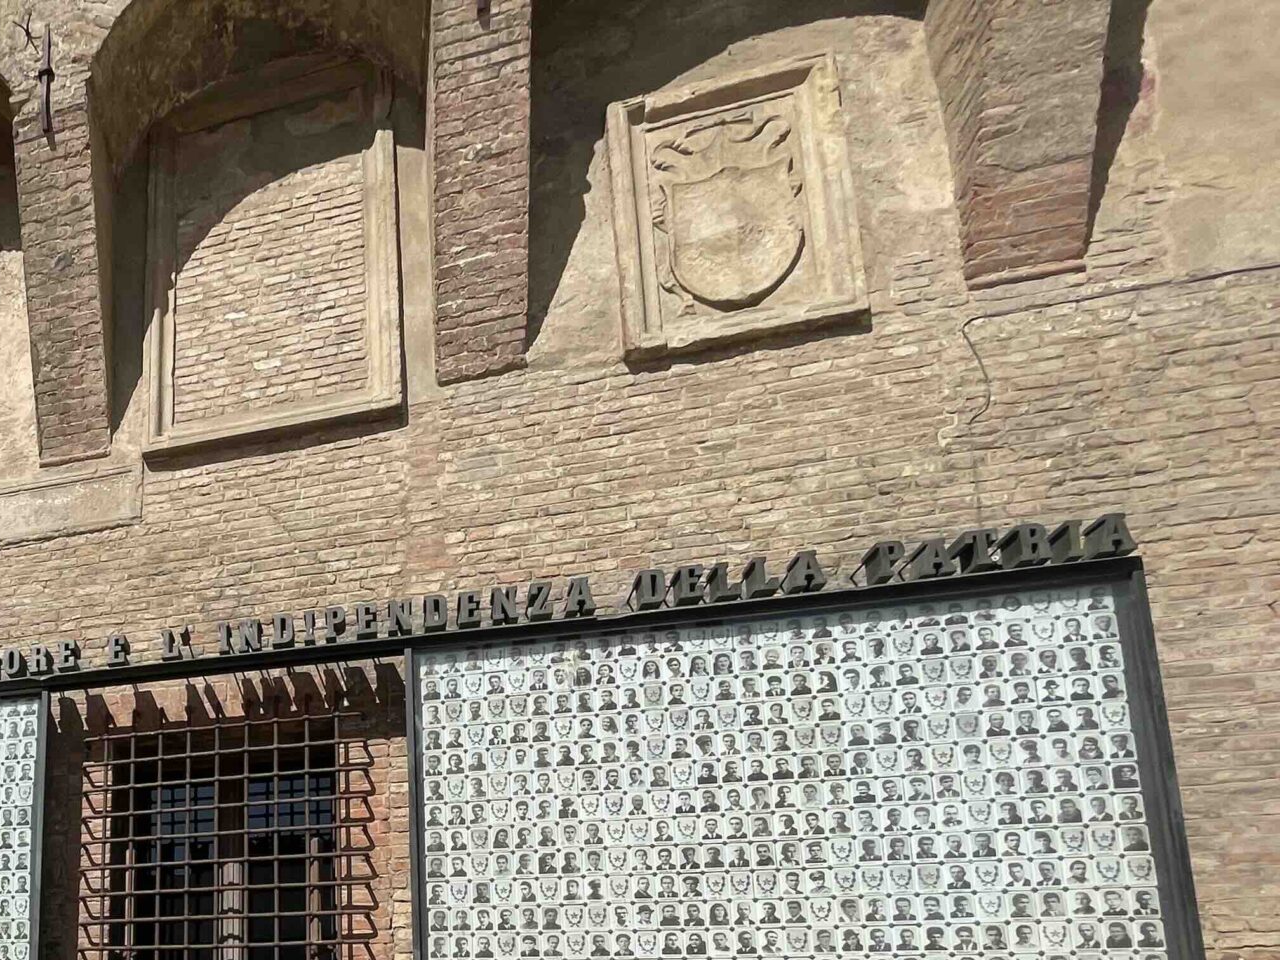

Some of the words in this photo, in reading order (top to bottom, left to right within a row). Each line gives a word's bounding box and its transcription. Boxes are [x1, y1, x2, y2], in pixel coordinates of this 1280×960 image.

[108, 634, 128, 666] E
[632, 549, 827, 610] DELLA
[864, 512, 1138, 583] PATRIA
